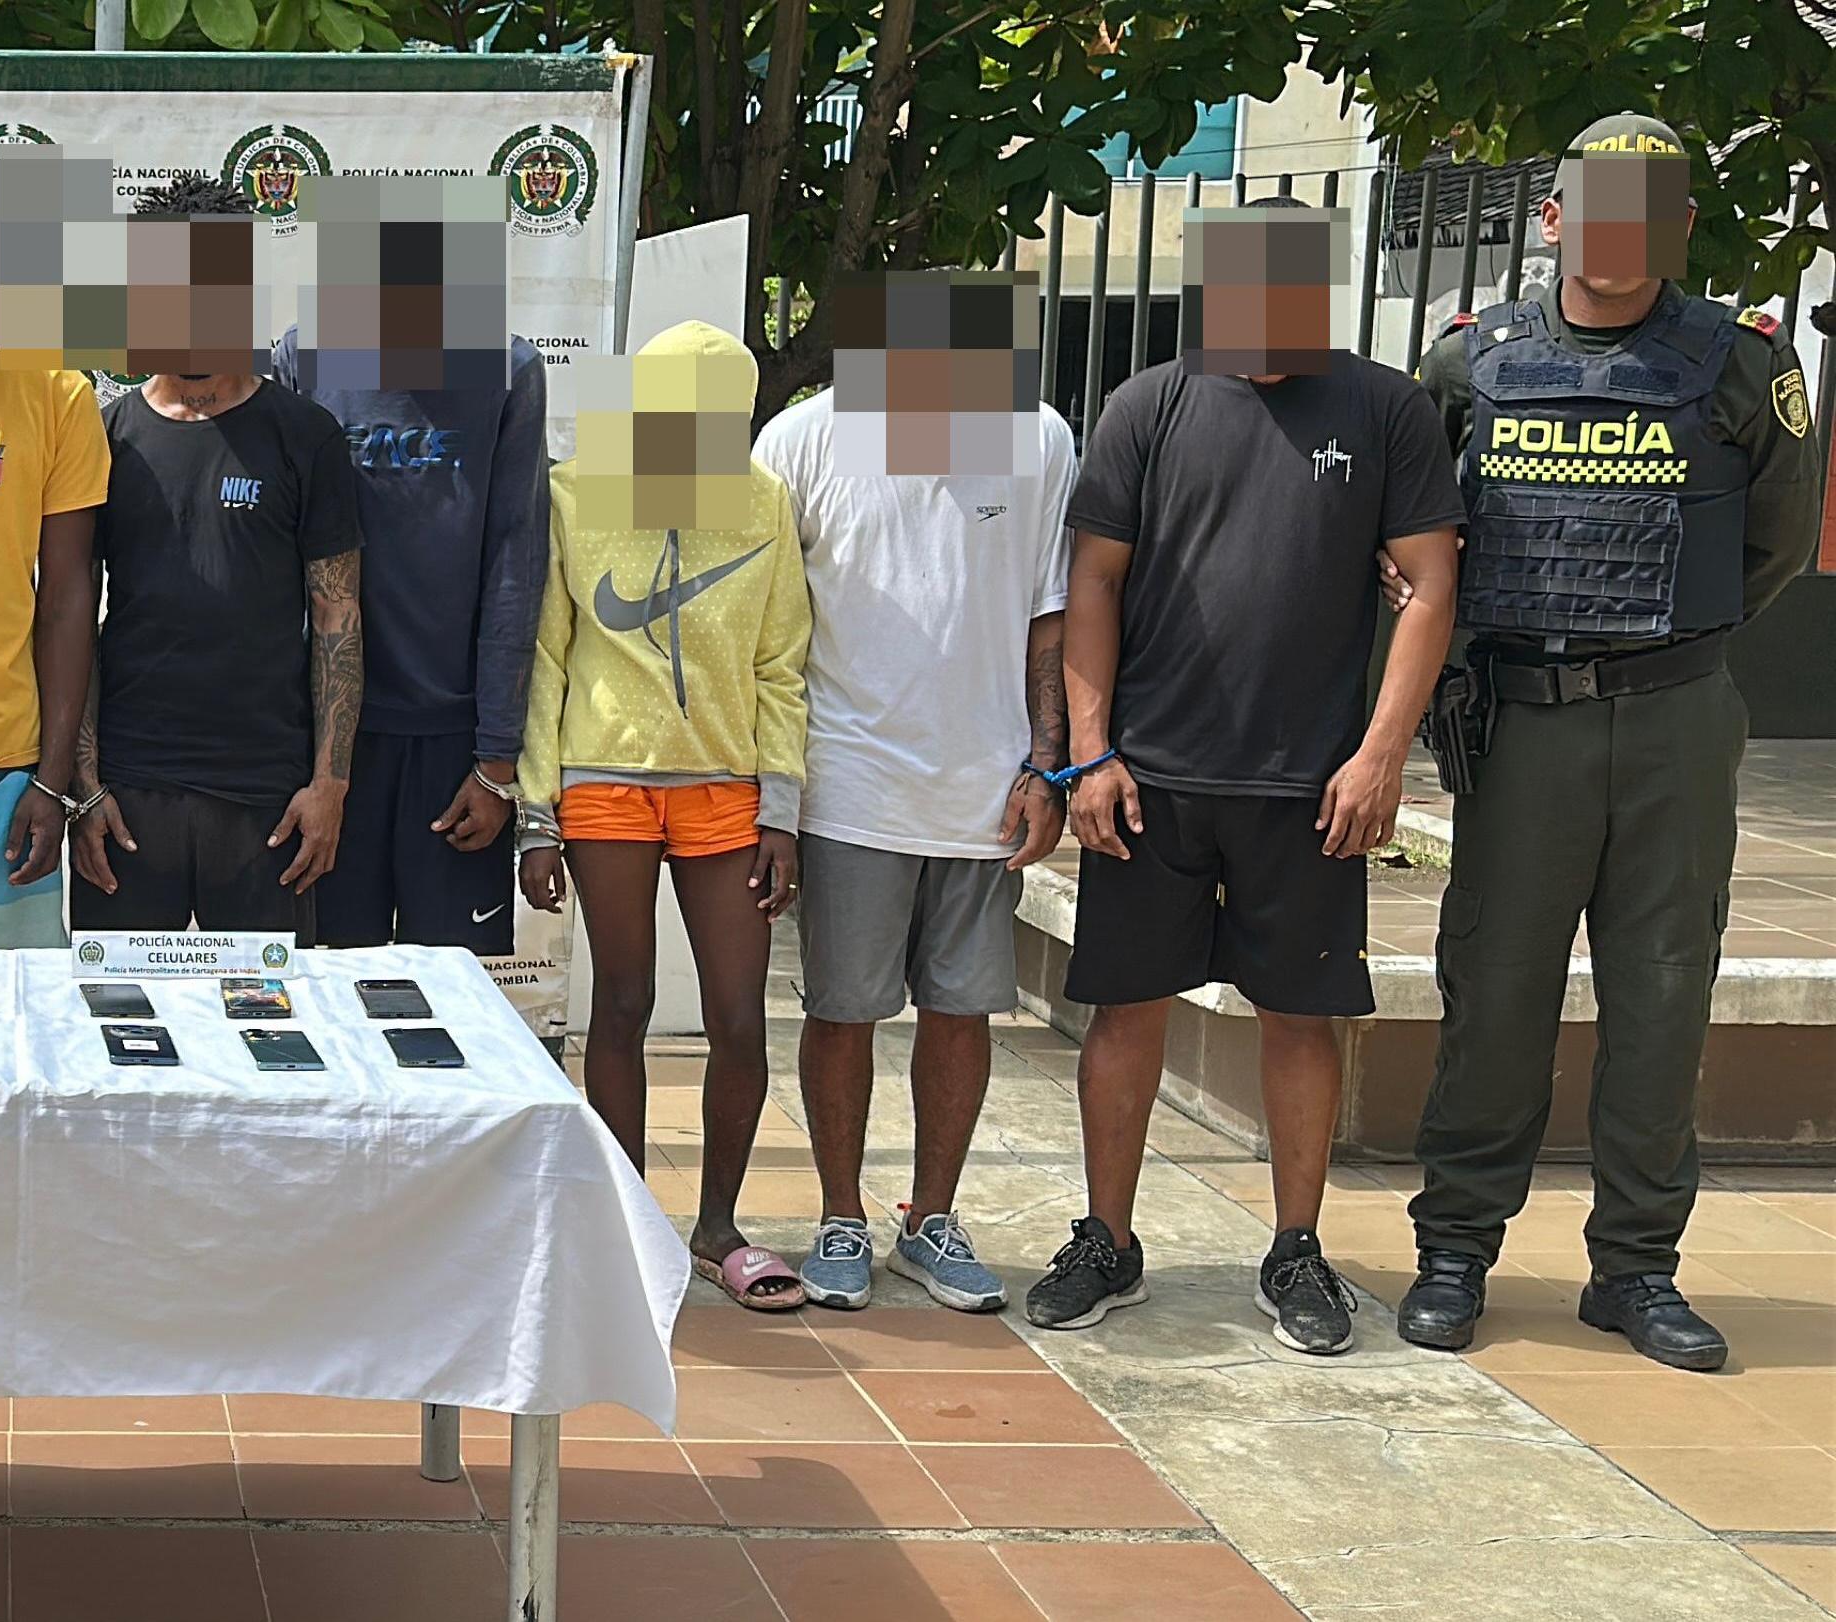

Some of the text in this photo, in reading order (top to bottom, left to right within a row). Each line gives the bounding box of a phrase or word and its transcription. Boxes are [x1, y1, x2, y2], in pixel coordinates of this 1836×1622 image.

[234, 142, 265, 182] EPUBLICA
[561, 142, 586, 187] COLOMBIA
[542, 196, 582, 222] NACIONAL
[541, 222, 572, 234] PATRIA
[1492, 410, 1675, 455] POLICÍA
[220, 476, 263, 504] NIKE
[129, 934, 236, 948] POLICÍA NACIONAL
[148, 952, 218, 964] CELULARES
[128, 967, 180, 975] Metropolitana
[192, 968, 228, 976] Cartagena
[493, 974, 540, 986] OMBIA
